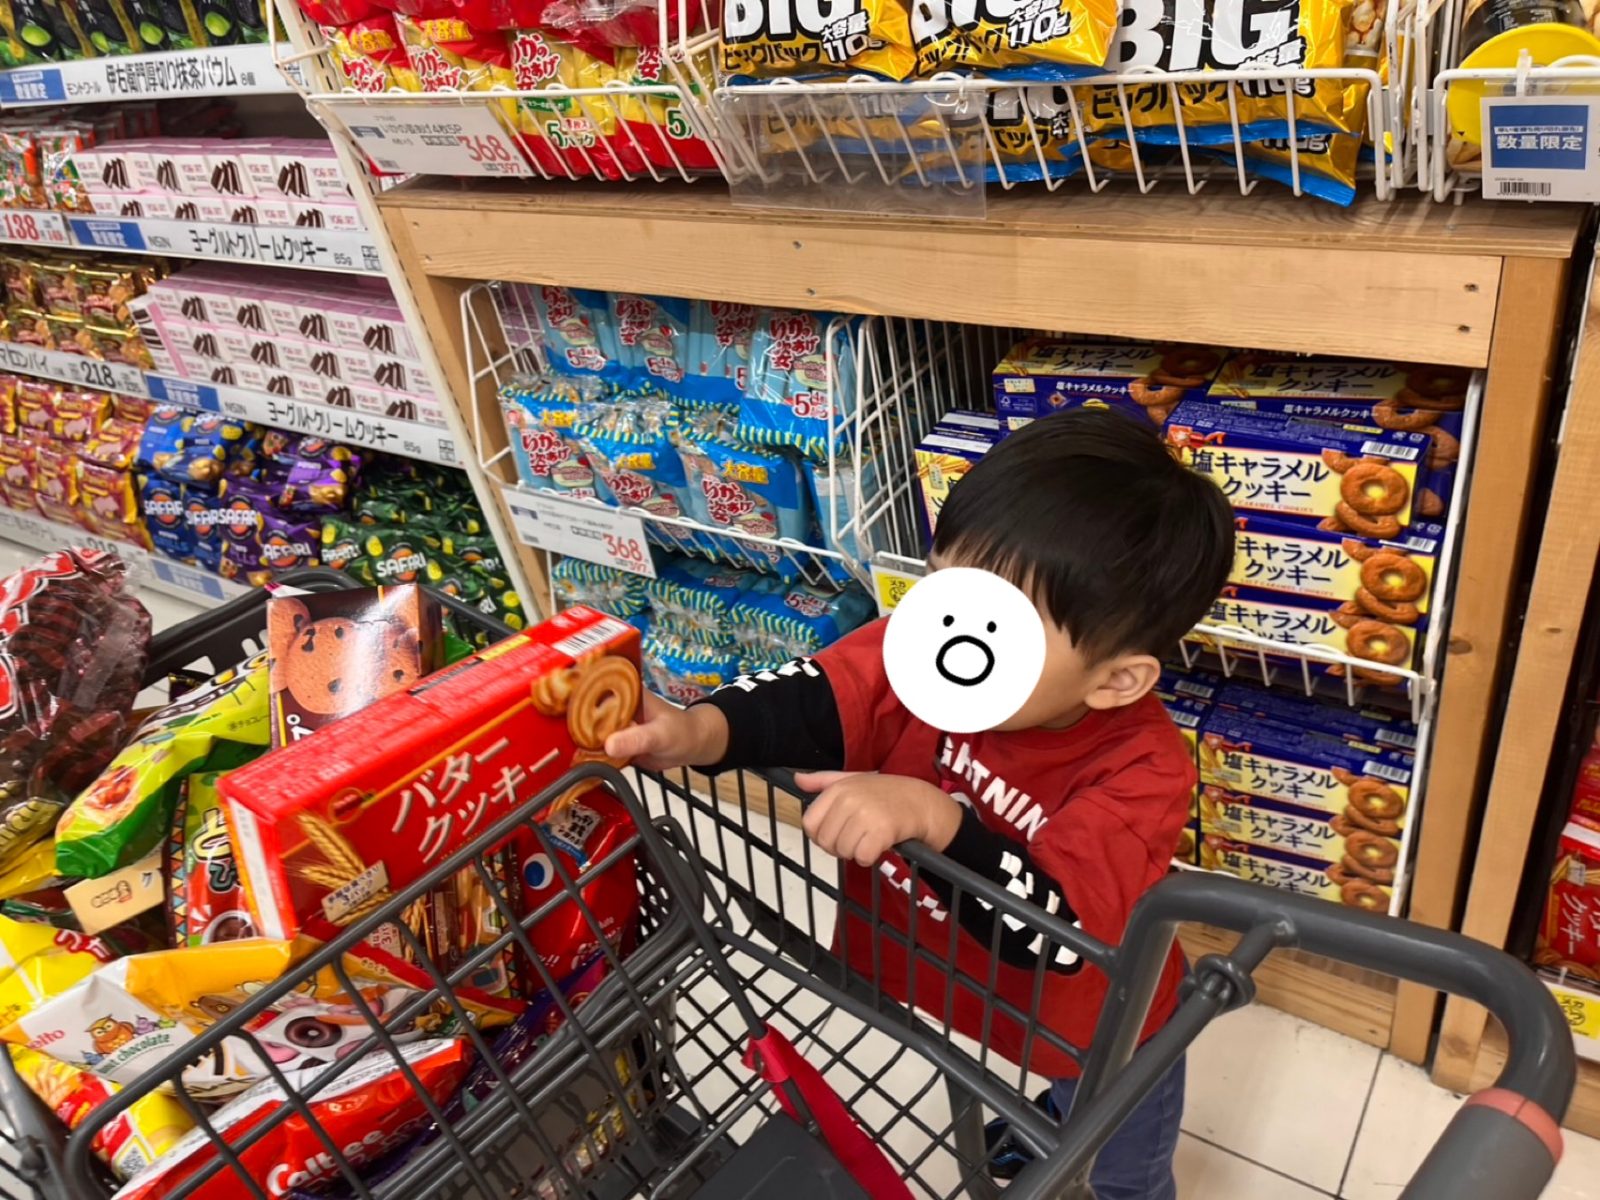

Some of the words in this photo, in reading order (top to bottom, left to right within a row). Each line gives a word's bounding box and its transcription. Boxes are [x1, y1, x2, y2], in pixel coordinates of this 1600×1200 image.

[1008, 10, 1071, 49] 110g
[457, 135, 512, 162] 368
[1496, 134, 1583, 151] 数量限定
[4, 214, 40, 242] 138
[189, 229, 328, 264] ヨーグルトクリームクッキー
[79, 360, 117, 389] 218
[1277, 377, 1376, 393] クッキー
[267, 402, 399, 446] ヨーグルトクリームクッキー
[1190, 449, 1330, 483] 塩キャラメル
[1222, 475, 1312, 503] クッキー
[602, 532, 644, 562] 368
[1234, 534, 1350, 570] キャラメル
[376, 551, 428, 578] SAFARI
[1244, 558, 1332, 586] クッキー
[1208, 600, 1337, 636] 塩キャラメル
[391, 736, 511, 833] バター
[1222, 751, 1340, 790] 塩キャラメル
[1250, 775, 1326, 800] クッキー
[417, 747, 561, 864] クッキー
[1222, 803, 1337, 841] 塩キャラメル
[1250, 825, 1324, 850] クッキー
[1222, 850, 1333, 889] 塩キャラメル
[1560, 891, 1588, 955] クッキー
[117, 1032, 172, 1062] chocolate
